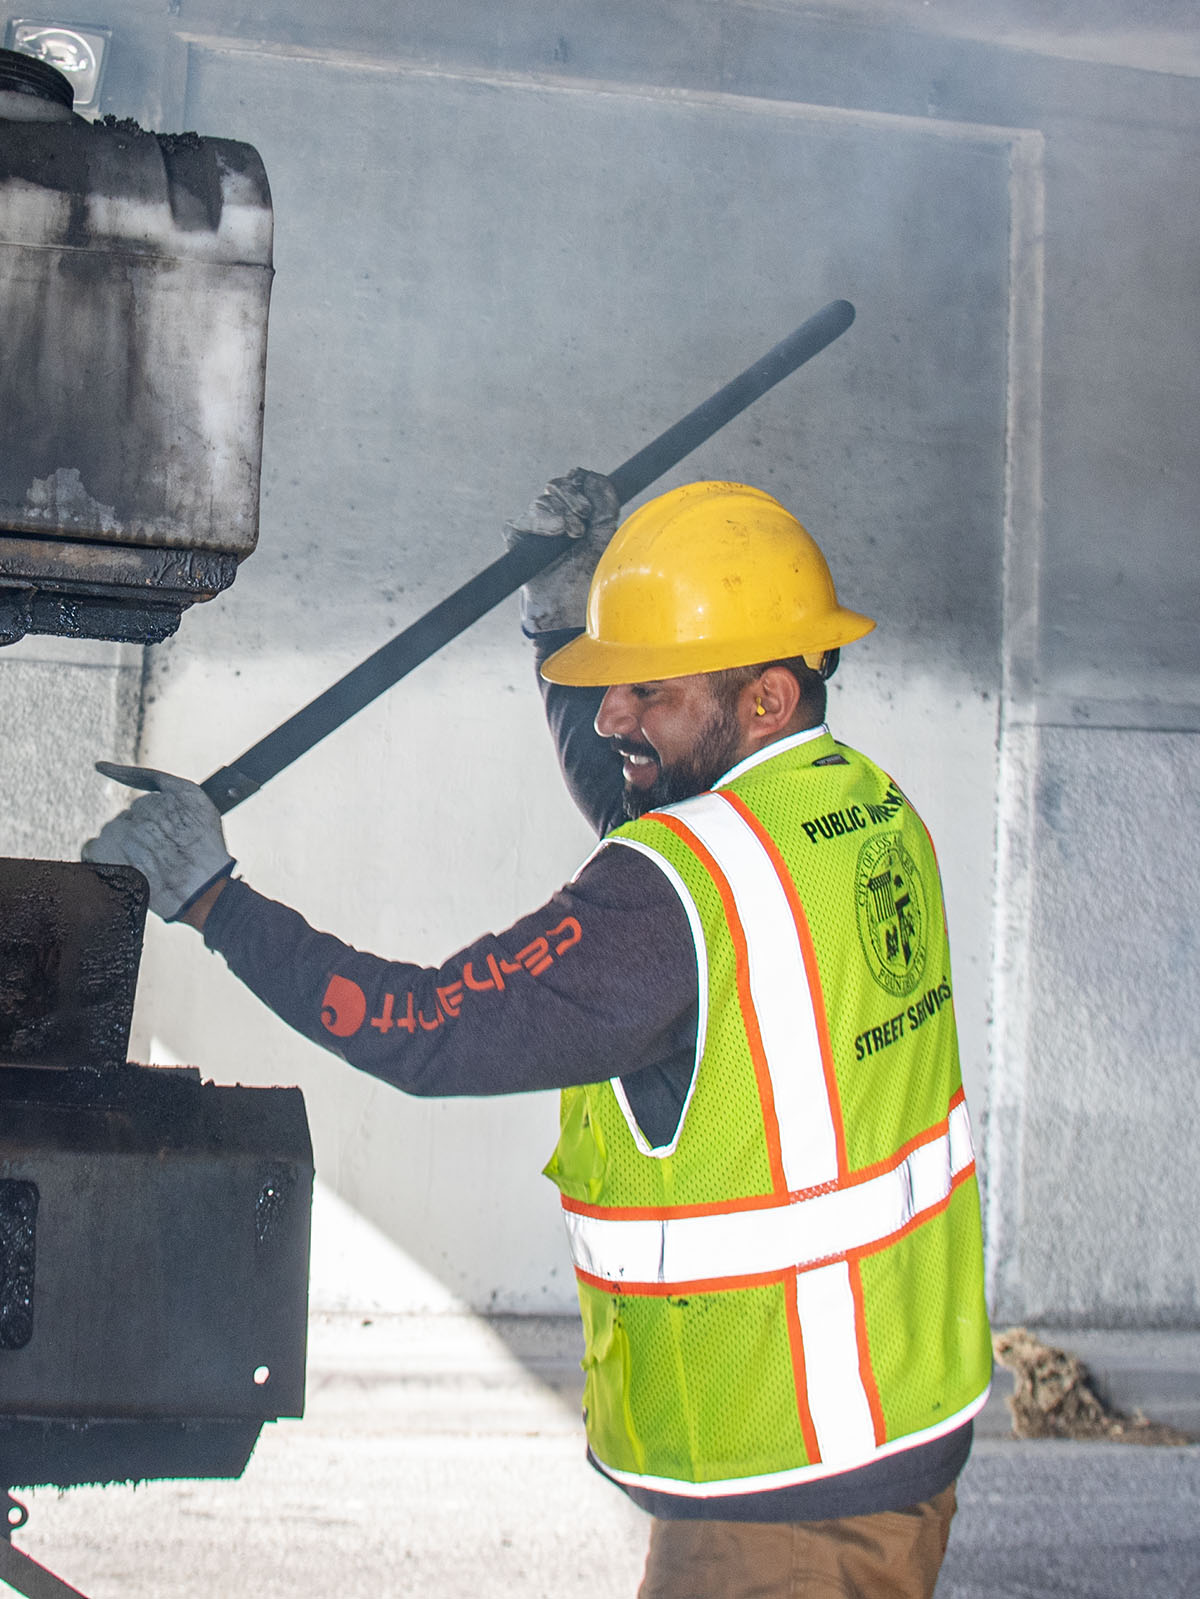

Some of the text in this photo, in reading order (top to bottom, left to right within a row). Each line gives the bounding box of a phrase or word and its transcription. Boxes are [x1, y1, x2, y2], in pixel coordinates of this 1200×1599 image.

[801, 782, 904, 845] PUBLIC WRK
[858, 836, 892, 907] CITY OF LOS
[854, 1012, 905, 1061] STREET
